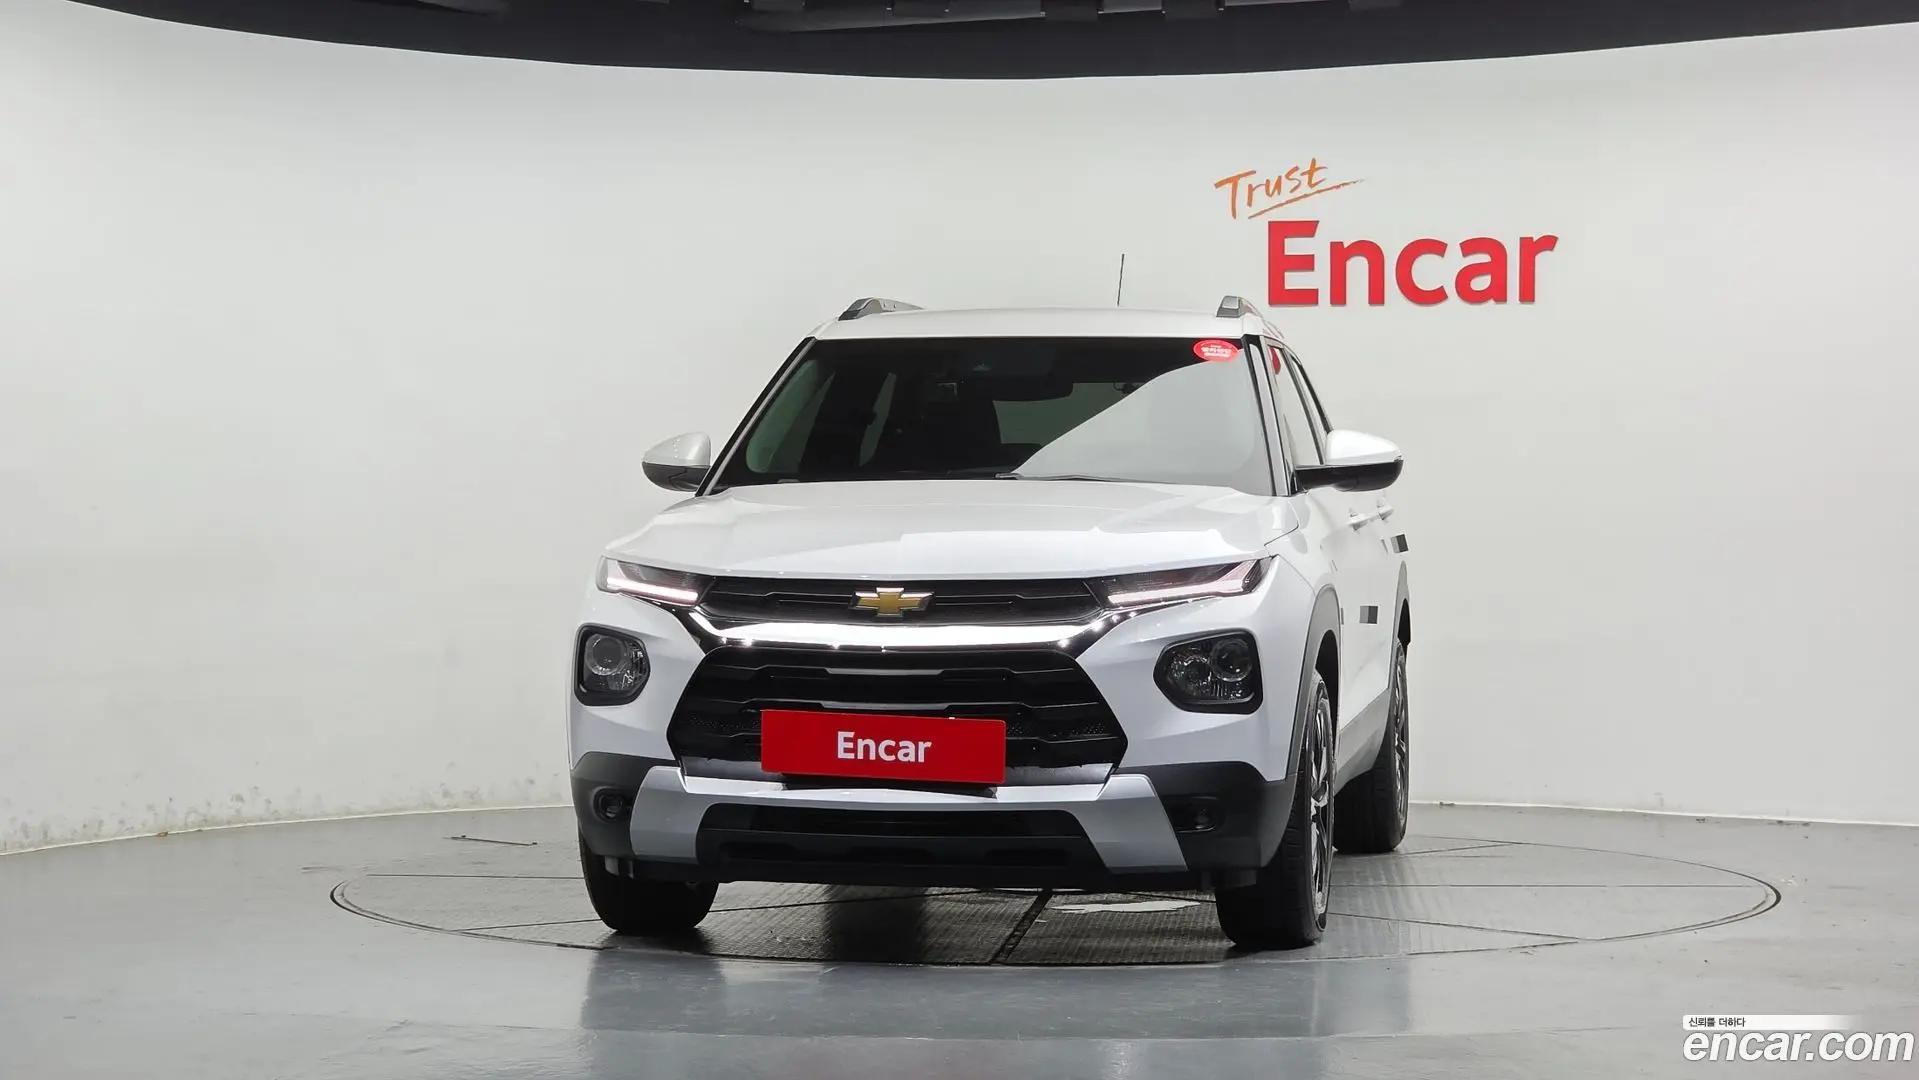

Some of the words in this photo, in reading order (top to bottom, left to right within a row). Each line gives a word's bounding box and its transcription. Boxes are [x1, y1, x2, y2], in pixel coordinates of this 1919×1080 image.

[1214, 158, 1328, 219] Trust
[1268, 220, 1559, 306] Encar
[837, 731, 932, 762] Encar
